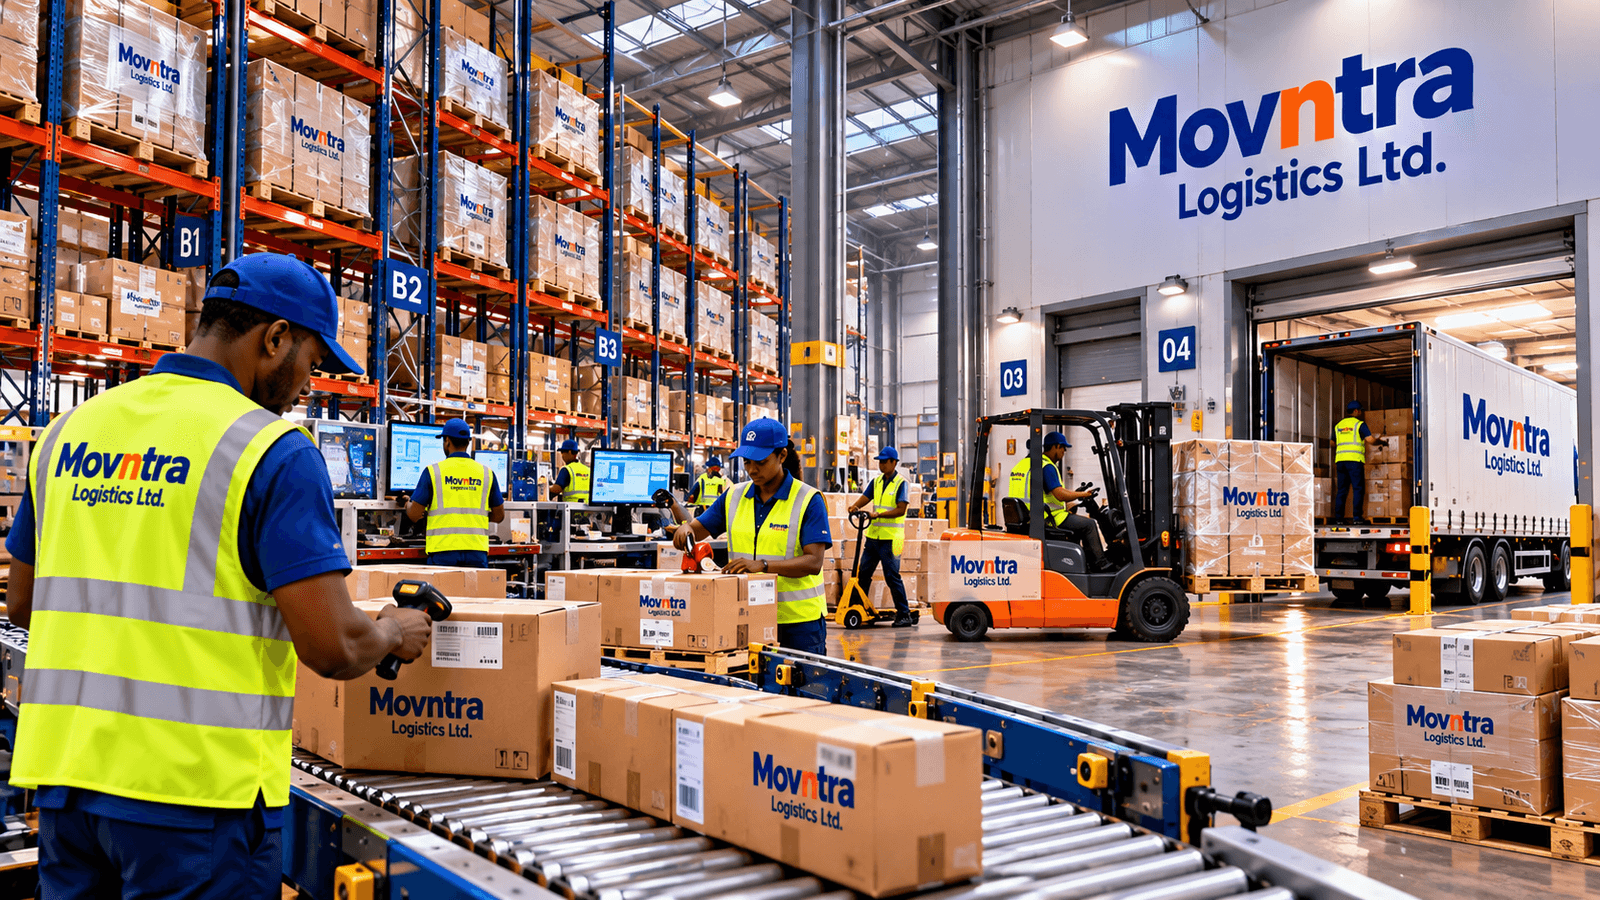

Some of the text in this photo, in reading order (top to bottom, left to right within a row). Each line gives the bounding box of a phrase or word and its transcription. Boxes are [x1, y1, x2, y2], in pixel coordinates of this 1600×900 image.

[118, 42, 180, 85] Movntra
[1109, 47, 1474, 186] Movntra
[291, 115, 345, 153] Movntra
[1179, 131, 1447, 220] Logistics Ltd.
[180, 227, 200, 258] B1
[392, 270, 422, 304] B2
[598, 336, 618, 360] B3
[1162, 336, 1191, 363] 04
[1003, 367, 1024, 390] 03
[1463, 392, 1550, 457] Movntra
[55, 442, 190, 485] Movntra
[1485, 449, 1543, 477] Logistics Ltd.
[445, 475, 482, 486] Movntra
[72, 483, 165, 507] Logistics Ltd.
[1223, 486, 1290, 506] Movntra
[1236, 508, 1284, 520] Logistics Ltd.
[951, 555, 1018, 574] Movntra
[964, 576, 1012, 588] Logistics Ltd.
[639, 595, 686, 610] Movntra
[370, 687, 484, 720] Movntra
[392, 720, 473, 738] Logistics Ltd.
[1407, 704, 1494, 735] Movntra
[1424, 731, 1486, 748] Logistics Ltd.
[753, 751, 855, 809] Movntra
[771, 795, 843, 831] Logistics Ltd.
